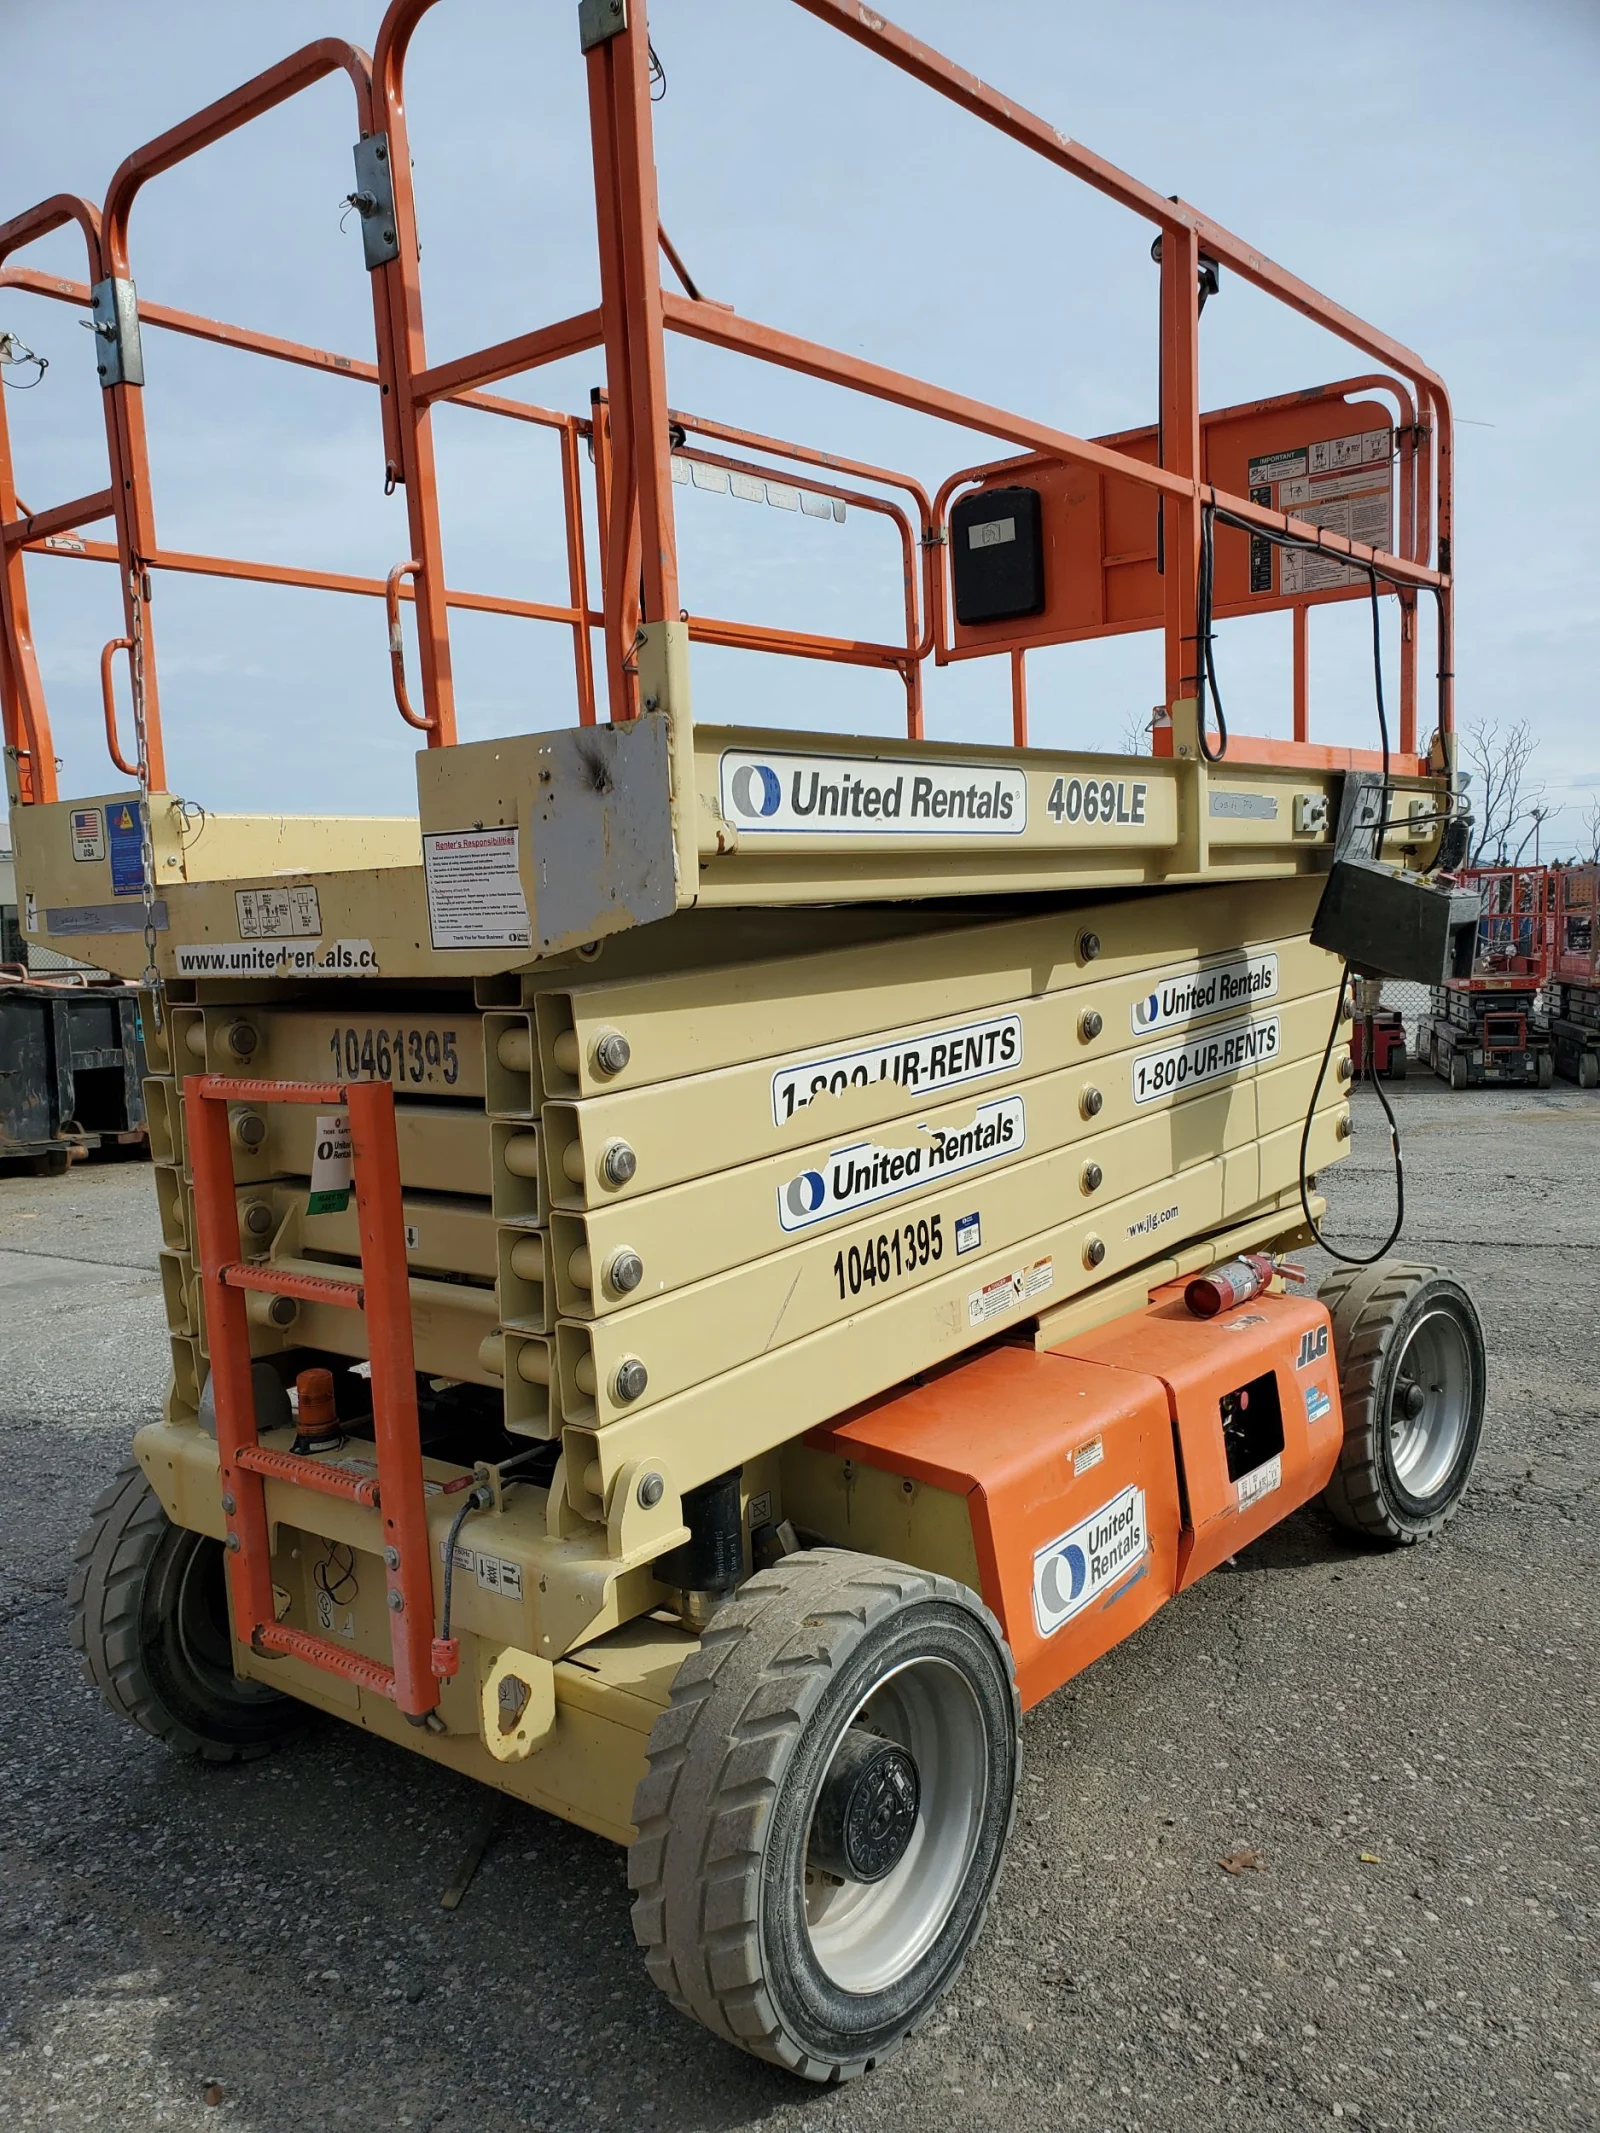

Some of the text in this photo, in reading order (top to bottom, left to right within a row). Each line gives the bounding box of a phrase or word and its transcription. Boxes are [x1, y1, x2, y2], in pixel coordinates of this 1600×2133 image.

[1260, 452, 1295, 464] IMPORTANT
[791, 769, 1014, 820] United Rentals
[1047, 777, 1147, 825] 4069LE
[83, 848, 95, 857] USA
[435, 836, 515, 850] Renter's Responsibilities
[1162, 964, 1272, 1017] United Rentals
[330, 1028, 459, 1084] 10461395
[1138, 1024, 1276, 1096] 1-800-UR-RENTS
[333, 1150, 351, 1159] Rental
[833, 1112, 1014, 1201] United Rentals
[833, 1213, 944, 1301] 10461395
[1296, 1324, 1328, 1370] JLG
[1088, 1497, 1134, 1555] United
[1089, 1525, 1141, 1586] Rentals
